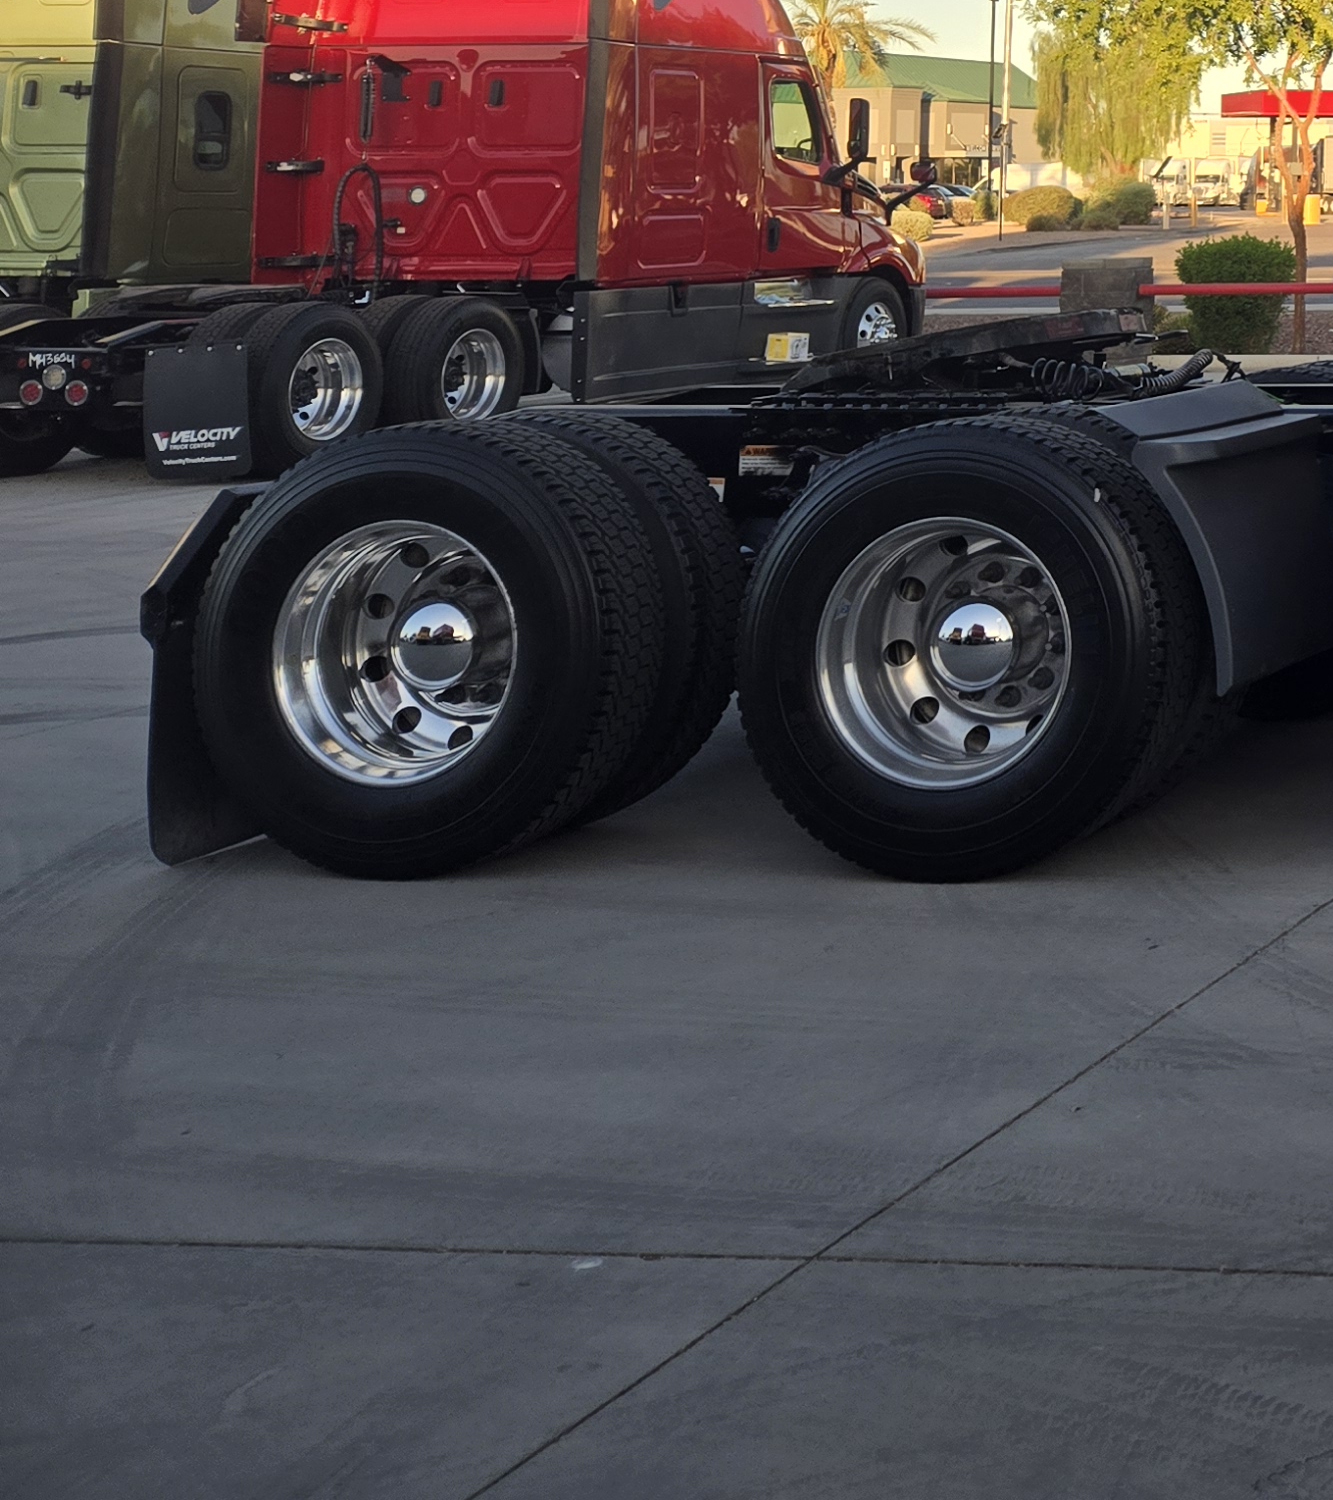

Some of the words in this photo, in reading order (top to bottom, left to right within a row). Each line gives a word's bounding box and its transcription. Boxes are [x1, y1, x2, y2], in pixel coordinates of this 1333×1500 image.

[170, 426, 242, 443] VELOCITY
[169, 443, 189, 451] TRUCK
[189, 442, 216, 450] CENTERS
